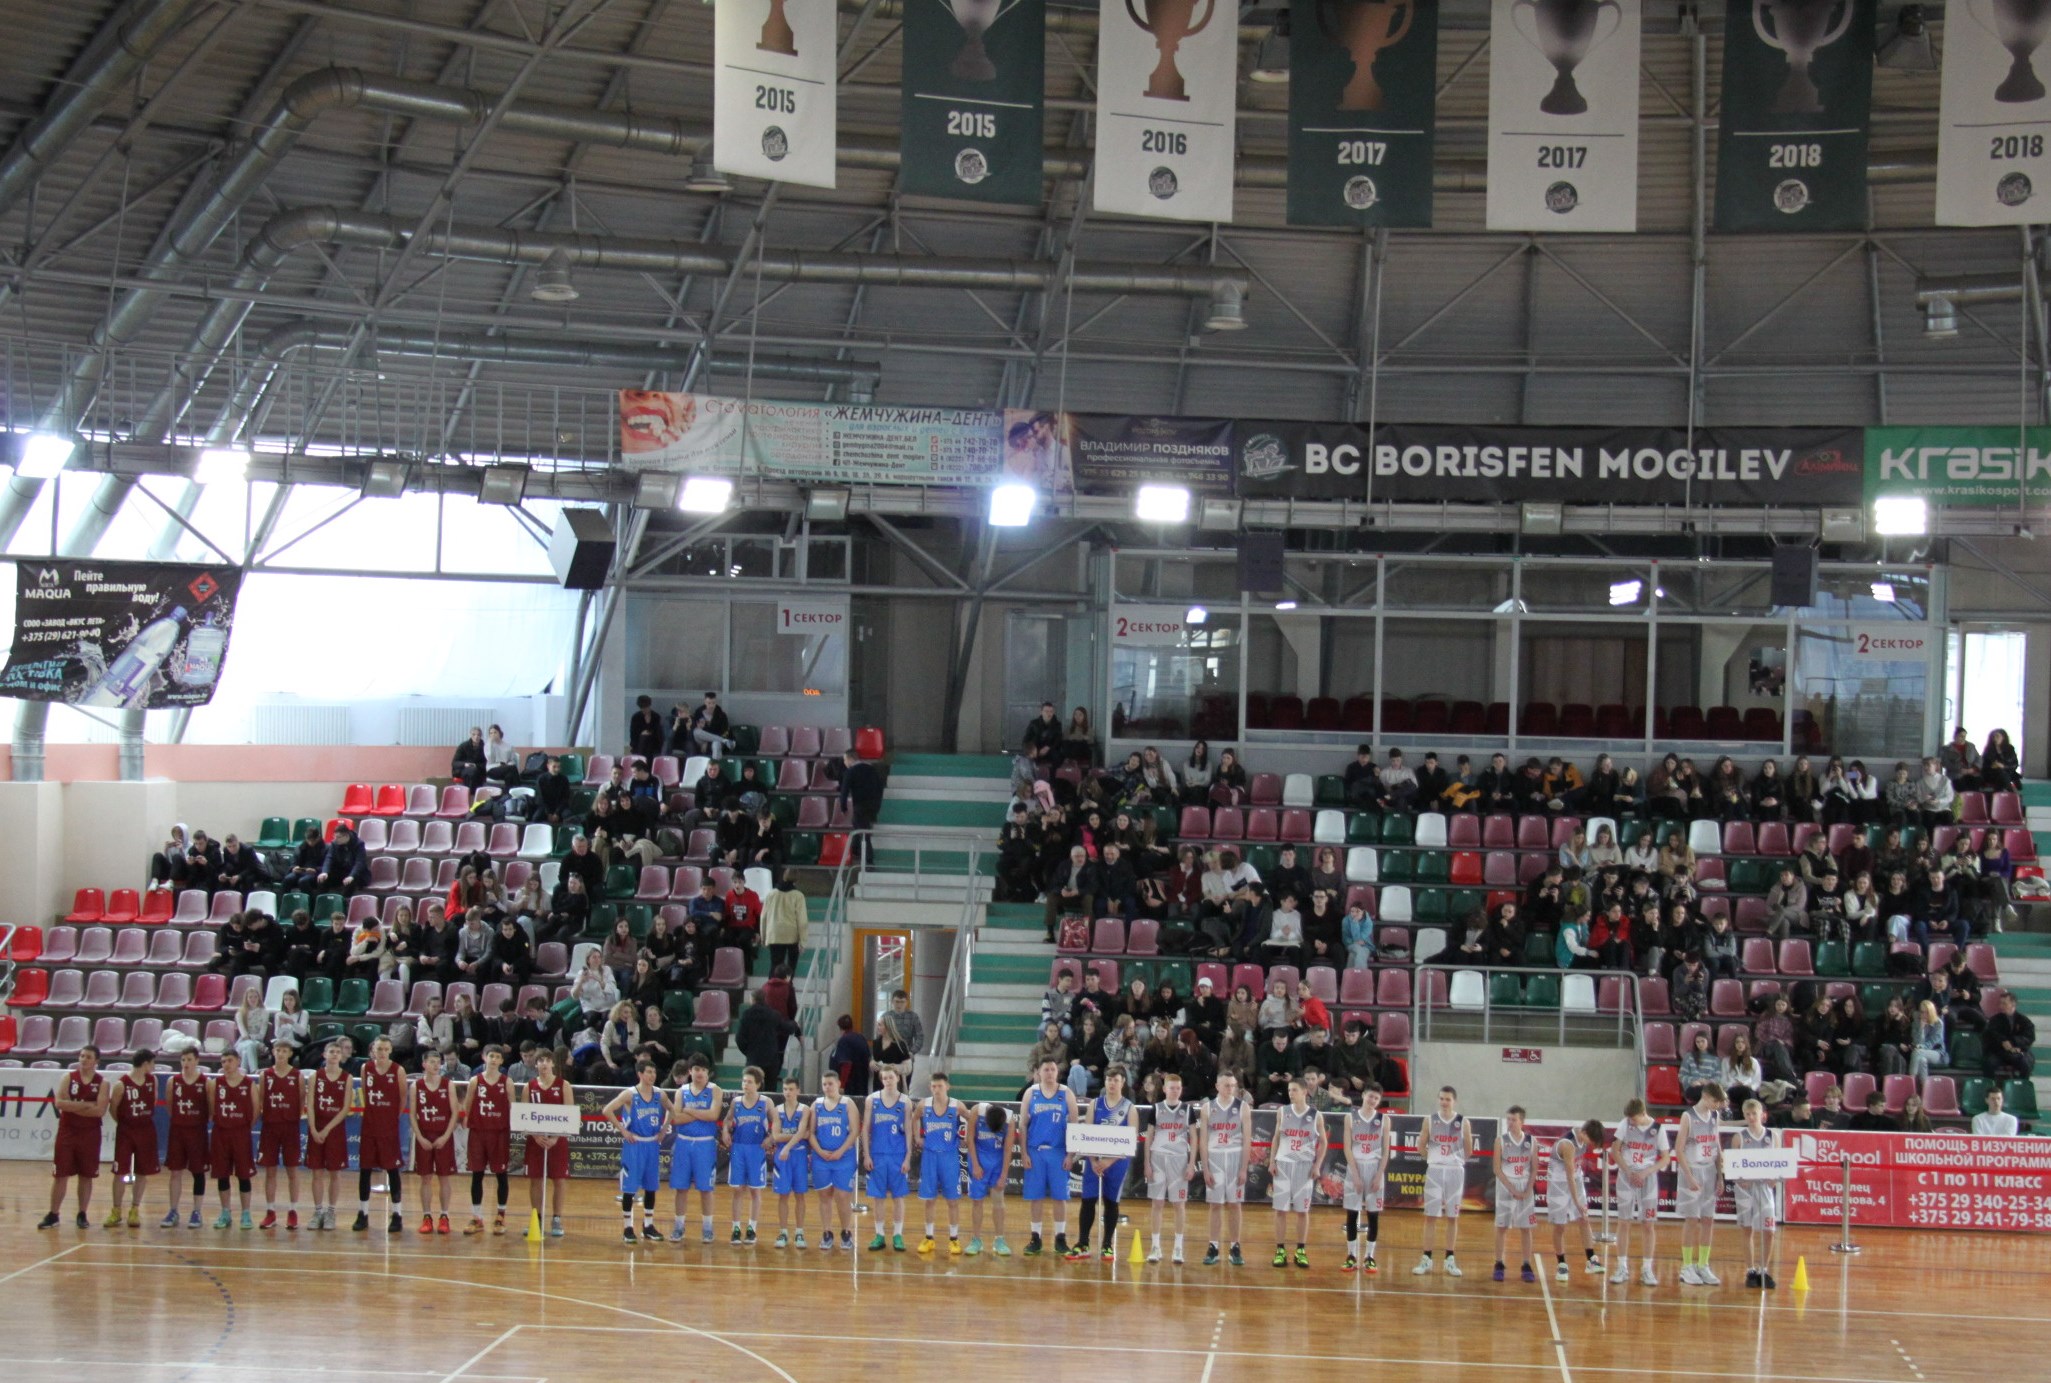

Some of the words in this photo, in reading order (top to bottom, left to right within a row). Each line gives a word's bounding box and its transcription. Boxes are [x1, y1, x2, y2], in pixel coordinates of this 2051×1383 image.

[755, 85, 796, 114] 2015
[947, 111, 996, 138] 2015
[1142, 129, 1187, 156] 2016
[1989, 135, 2044, 160] 2018
[1337, 140, 1386, 166] 2017
[1537, 145, 1588, 169] 2017
[1769, 143, 1821, 168] 2018
[1080, 440, 1150, 453] ВЛАДИМИР
[1153, 443, 1229, 456] ПОЗДНЯКОВ
[1306, 443, 1360, 472] BC
[1376, 444, 1583, 478] BORISFEN
[1600, 447, 1790, 481] MOGILEV
[74, 570, 104, 582] Пейте
[25, 588, 71, 599] MAQUA
[86, 583, 147, 595] правильную
[132, 592, 160, 604] воду!
[782, 609, 791, 628] 1
[794, 612, 842, 624] СЕКТОР
[1116, 618, 1128, 637] 2
[1130, 622, 1179, 634] СЕКТОР
[22, 632, 43, 643] +375
[44, 631, 61, 642] (29)
[1858, 633, 1869, 654] 2
[1871, 638, 1924, 650] СЕКТОР
[267, 1078, 274, 1090] 7
[318, 1082, 324, 1092] 3
[366, 1076, 374, 1087] 6
[71, 1084, 80, 1094] 8
[126, 1088, 139, 1100] 10
[175, 1086, 182, 1097] 4
[219, 1088, 226, 1099] 9
[420, 1092, 427, 1104] 5
[530, 1092, 541, 1104] 11
[530, 1111, 569, 1124] Брянск
[1052, 1112, 1060, 1122] 17
[832, 1126, 841, 1136] 10
[892, 1124, 898, 1134] 9
[1080, 1134, 1130, 1145] Звенигород
[1218, 1132, 1228, 1144] 24
[1290, 1140, 1302, 1152] 22
[1361, 1143, 1372, 1154] 56
[1440, 1144, 1452, 1156] 57
[1818, 1140, 1838, 1151] my
[1904, 1138, 1968, 1152] ПОМОЩЬ
[1971, 1140, 1980, 1150] В
[1632, 1152, 1644, 1164] 64
[1742, 1158, 1789, 1169] Вологда
[1817, 1150, 1880, 1165] School
[1896, 1152, 1974, 1167] ШКОЛЬНОЙ
[1806, 1180, 1822, 1192] ТЦ
[1918, 1172, 1926, 1184] с
[1930, 1172, 1939, 1185] 1
[1944, 1174, 1966, 1186] по
[1970, 1173, 1988, 1187] 11
[1994, 1176, 2042, 1188] класс
[1792, 1194, 1808, 1204] ул.
[1878, 1196, 1886, 1204] 4
[1908, 1192, 1947, 1208] +375
[1950, 1193, 1970, 1208] 29
[1974, 1194, 2051, 1211] 340-25-34
[1820, 1206, 1843, 1216] каб.
[1908, 1209, 1948, 1224] +375
[1951, 1210, 1971, 1225] 29
[1974, 1211, 2051, 1228] 241-79-58
